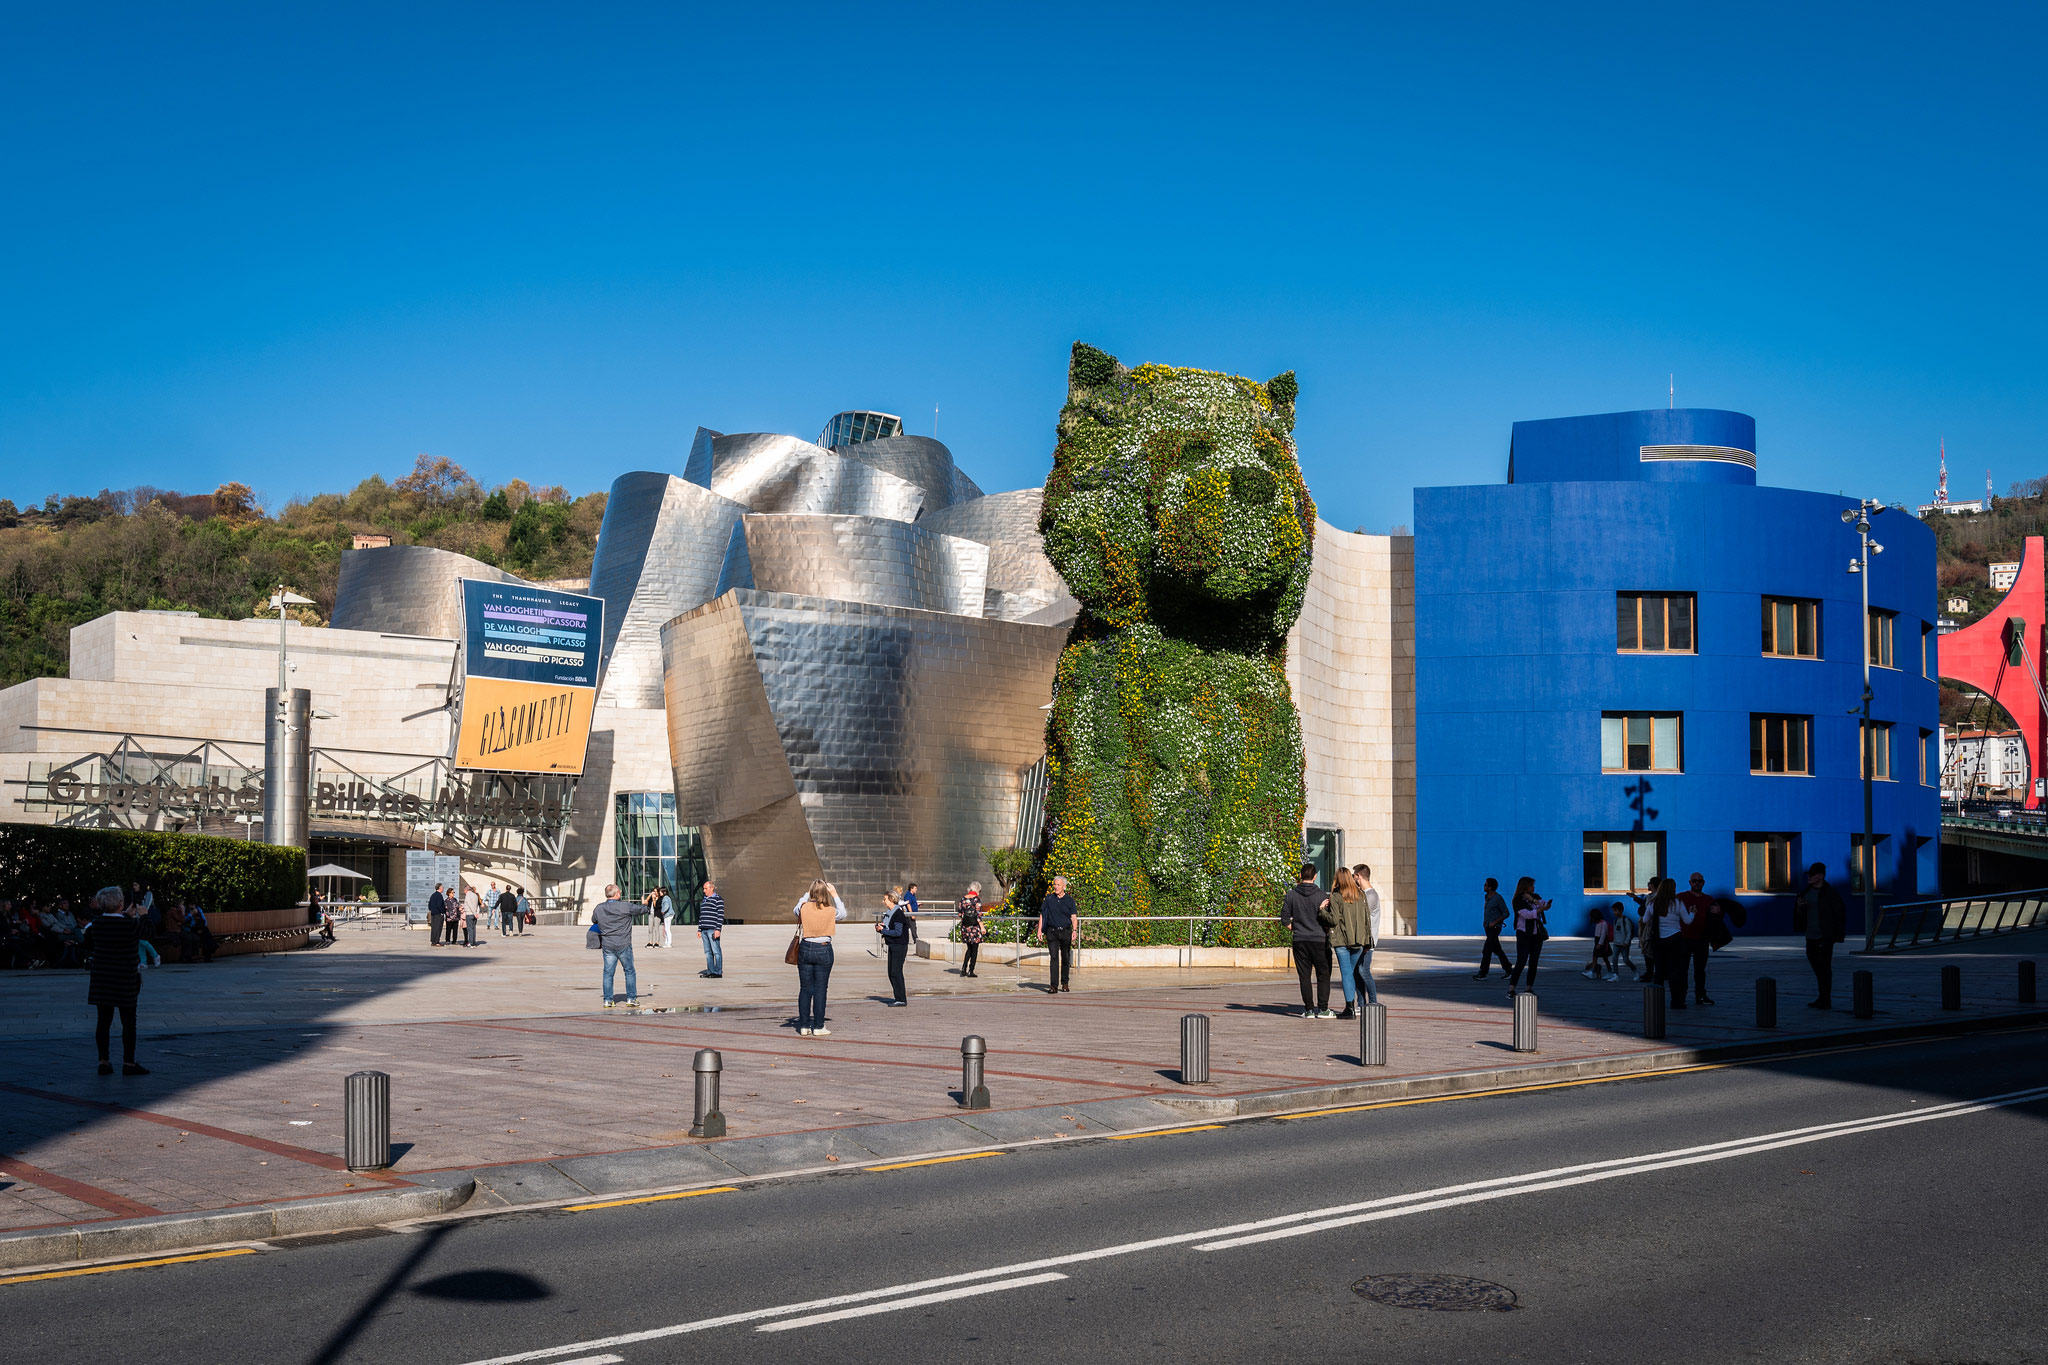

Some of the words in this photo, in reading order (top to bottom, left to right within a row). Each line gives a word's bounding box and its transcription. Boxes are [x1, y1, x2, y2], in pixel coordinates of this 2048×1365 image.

[484, 603, 502, 612] VAN
[484, 622, 495, 631] DE
[497, 623, 515, 632] VAN
[517, 625, 541, 635] GOGH
[543, 617, 586, 628] PICASSORA
[484, 641, 503, 651] VAN
[504, 644, 529, 654] GOGH
[553, 637, 586, 648] PICASSO
[539, 655, 550, 663] TO
[551, 657, 584, 667] PICASSO
[479, 692, 574, 757] GIACOMETTI
[50, 771, 312, 814] Guggenhei
[316, 781, 421, 815] Bilbao
[435, 787, 562, 820] Museoa
